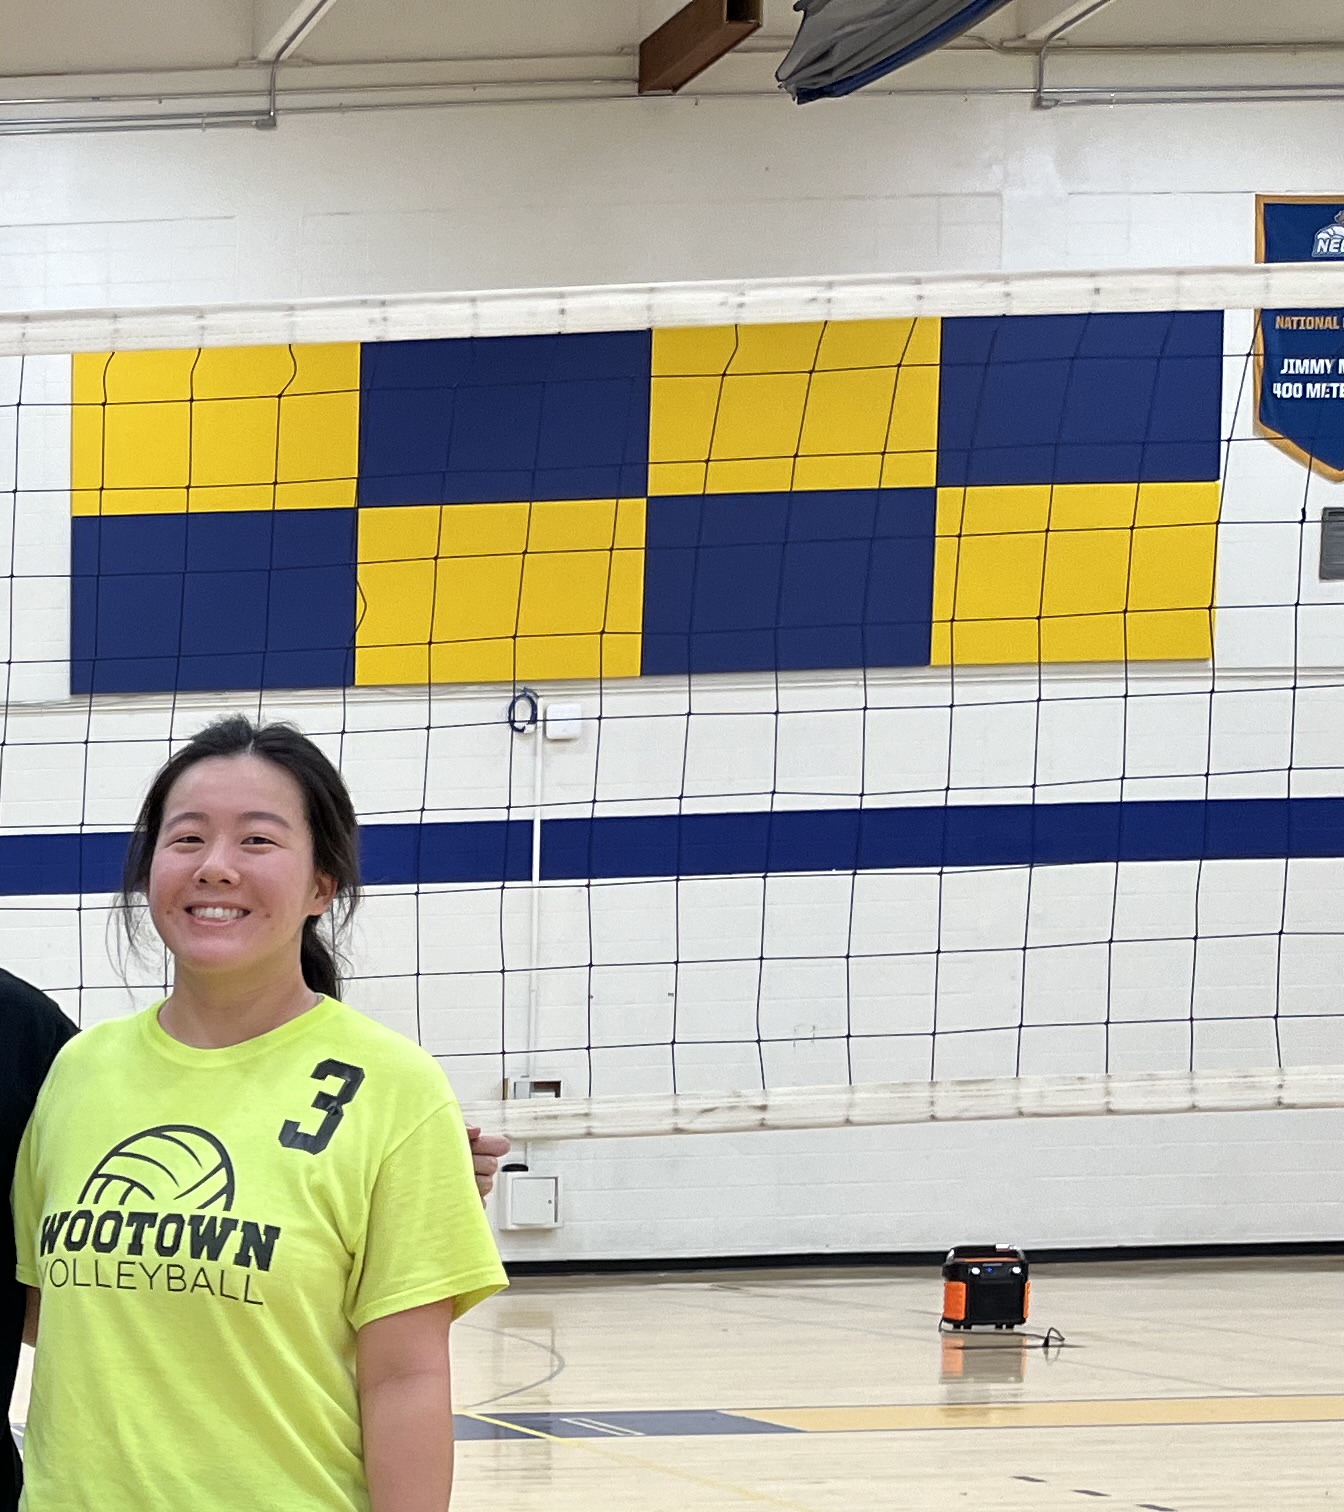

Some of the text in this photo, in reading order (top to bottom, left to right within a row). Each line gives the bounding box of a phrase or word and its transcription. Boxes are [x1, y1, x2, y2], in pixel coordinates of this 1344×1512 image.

[1317, 238, 1344, 253] NE
[1275, 315, 1340, 330] NATIONAL
[1280, 358, 1336, 375] JIMMY
[1272, 382, 1303, 399] 400
[277, 1057, 366, 1156] 3
[39, 1209, 282, 1272] WOOTOWN
[38, 1257, 264, 1306] VOLLEYBALL
